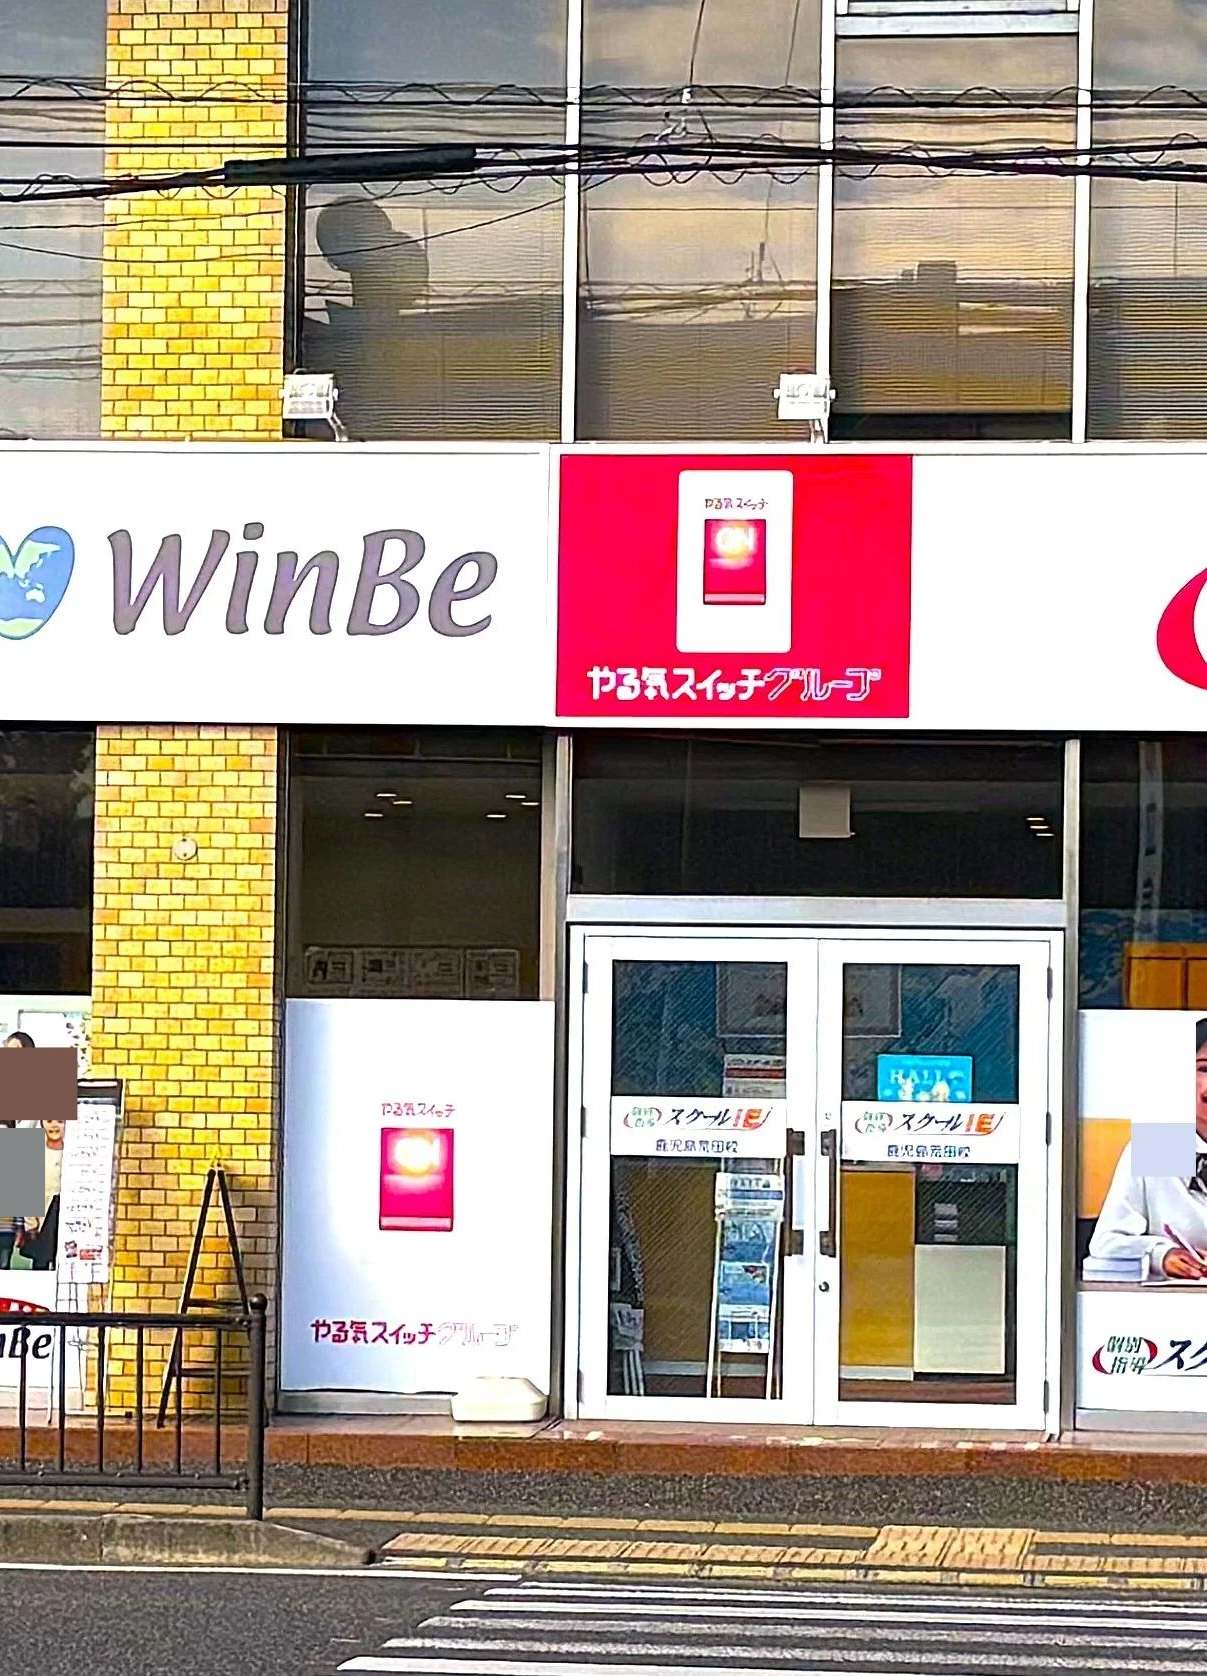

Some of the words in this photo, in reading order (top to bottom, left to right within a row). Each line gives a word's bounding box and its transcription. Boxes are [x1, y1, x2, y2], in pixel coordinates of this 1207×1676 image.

[107, 521, 499, 637] WinBe
[586, 665, 883, 703] やる気スイッチグループ
